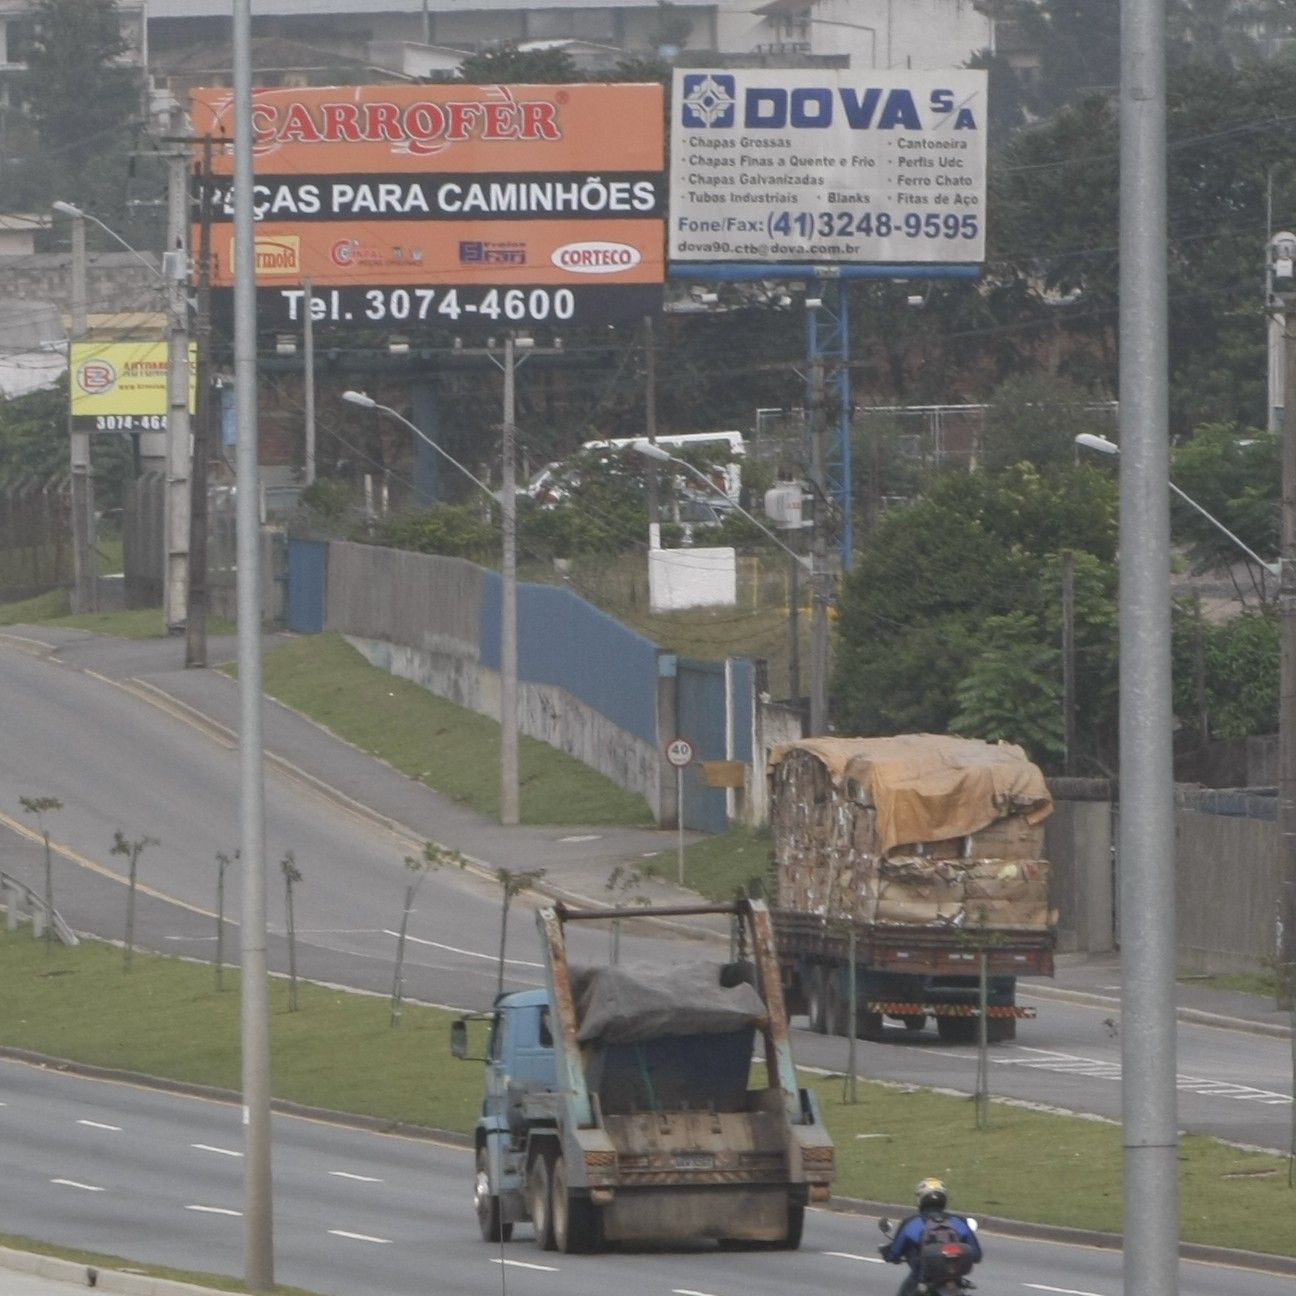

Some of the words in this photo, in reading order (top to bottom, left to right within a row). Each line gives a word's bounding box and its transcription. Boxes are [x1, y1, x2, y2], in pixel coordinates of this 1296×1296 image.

[745, 88, 922, 130] DOVA
[250, 99, 561, 143] CARROFER
[689, 137, 736, 150] Chapas
[740, 137, 792, 148] Grossas
[897, 138, 968, 150] Cantoneira
[689, 154, 735, 168] Chapas
[740, 154, 773, 166] Finas
[790, 155, 836, 168] Quente
[840, 158, 848, 166] e
[853, 156, 876, 168] Frio
[898, 156, 936, 168] Perfis
[688, 172, 735, 187] Chapas
[739, 172, 825, 186] Galvanizadas
[897, 174, 932, 186] Ferro
[937, 174, 973, 187] Chato
[331, 184, 429, 213] PARA
[438, 177, 656, 213] CAMINHÕES
[688, 190, 725, 204] Tubos
[729, 190, 799, 204] Industriais
[828, 191, 871, 204] Blanks
[897, 191, 932, 204] Fitas
[935, 192, 951, 205] de
[678, 217, 764, 233] Fone/Fax:
[561, 250, 632, 265] CORTECO
[282, 291, 352, 319] Tel.
[365, 289, 575, 319] 3074-4600
